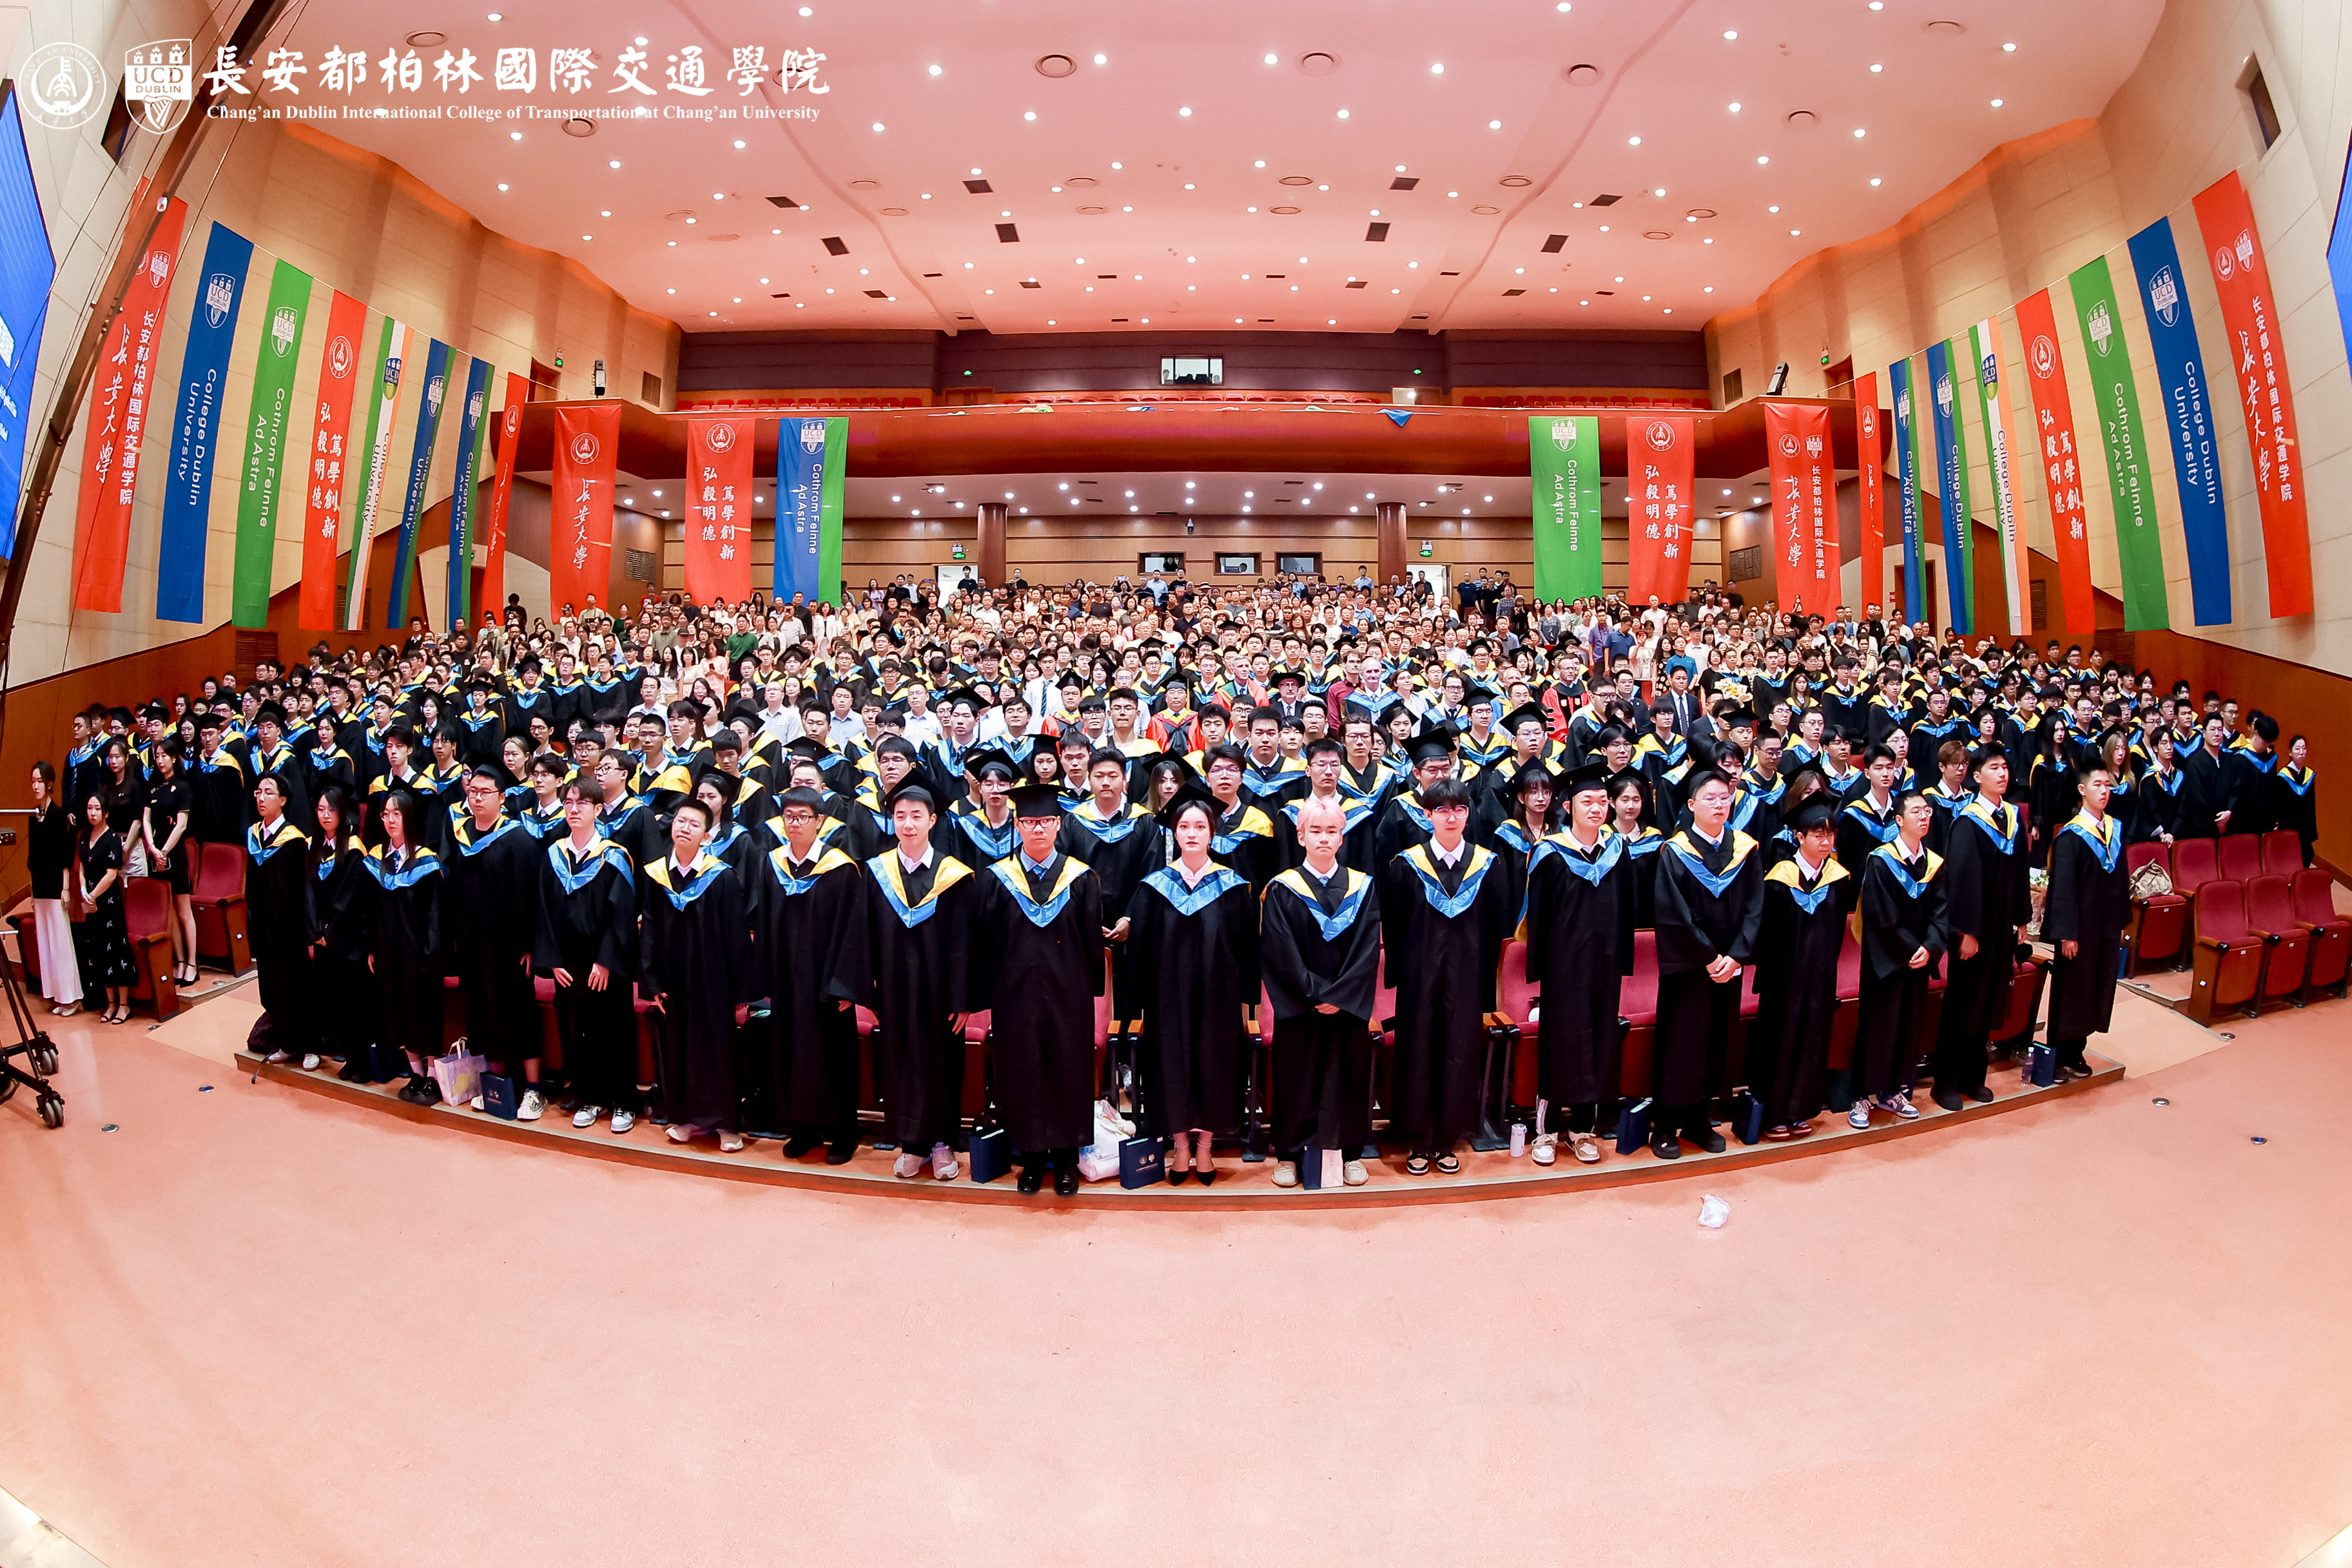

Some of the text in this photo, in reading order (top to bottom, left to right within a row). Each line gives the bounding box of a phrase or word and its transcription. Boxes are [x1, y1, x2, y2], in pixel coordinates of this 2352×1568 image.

[211, 285, 229, 302] UCD
[277, 318, 293, 333] UCD
[2091, 316, 2107, 332] UCD
[2154, 284, 2172, 300] UCD
[385, 367, 399, 380] UCD
[1983, 367, 1996, 380] UCD
[179, 382, 200, 481] University
[189, 368, 217, 506] College Dublin
[248, 414, 267, 492] Ad Astra
[259, 387, 285, 528] Cothrom Feinne
[2108, 421, 2126, 498] Ad Astra
[2114, 382, 2144, 527] Cothrom Feinne
[2174, 386, 2198, 486] University
[2185, 361, 2216, 505] College Dublin
[362, 444, 381, 522] University
[405, 458, 424, 530] University
[462, 452, 474, 508] Cothrom
[796, 483, 808, 534] Ad Astra
[808, 463, 822, 554] Cothrom Feinne
[1554, 474, 1565, 524] Ad Astra
[1568, 460, 1579, 551] Cothrom Feinne
[1903, 476, 1912, 534] Ad Astra
[1952, 445, 1965, 548] College Dublin
[1997, 430, 2016, 542] College Dublin
[1812, 465, 1825, 579] 长安都柏林国际交通学院
